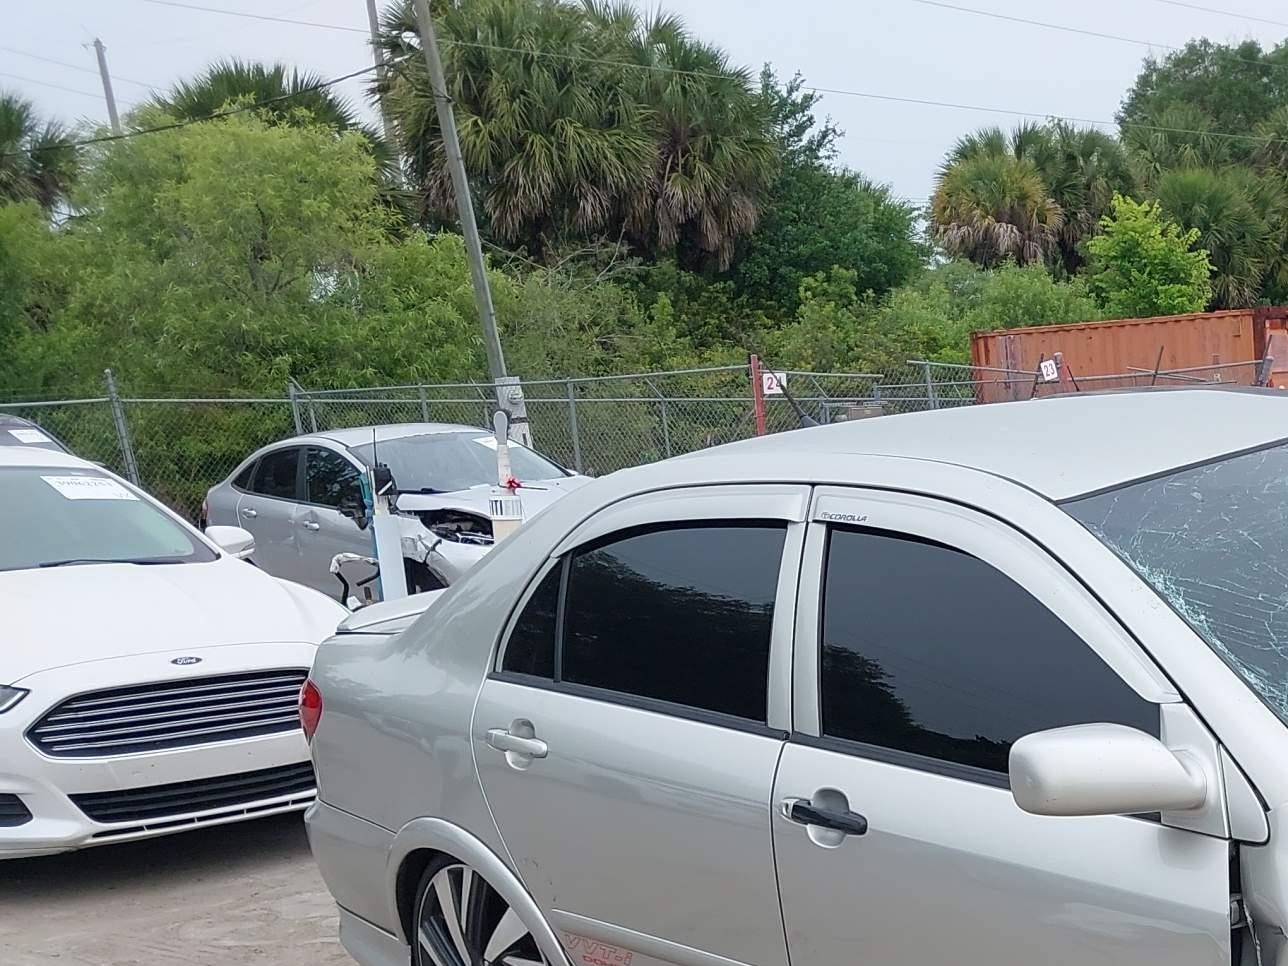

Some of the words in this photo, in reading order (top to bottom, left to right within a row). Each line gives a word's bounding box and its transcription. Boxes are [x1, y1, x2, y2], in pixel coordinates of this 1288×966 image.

[1043, 363, 1055, 377] 23
[829, 513, 868, 522] COROLLA
[564, 934, 633, 966] VVT-i
